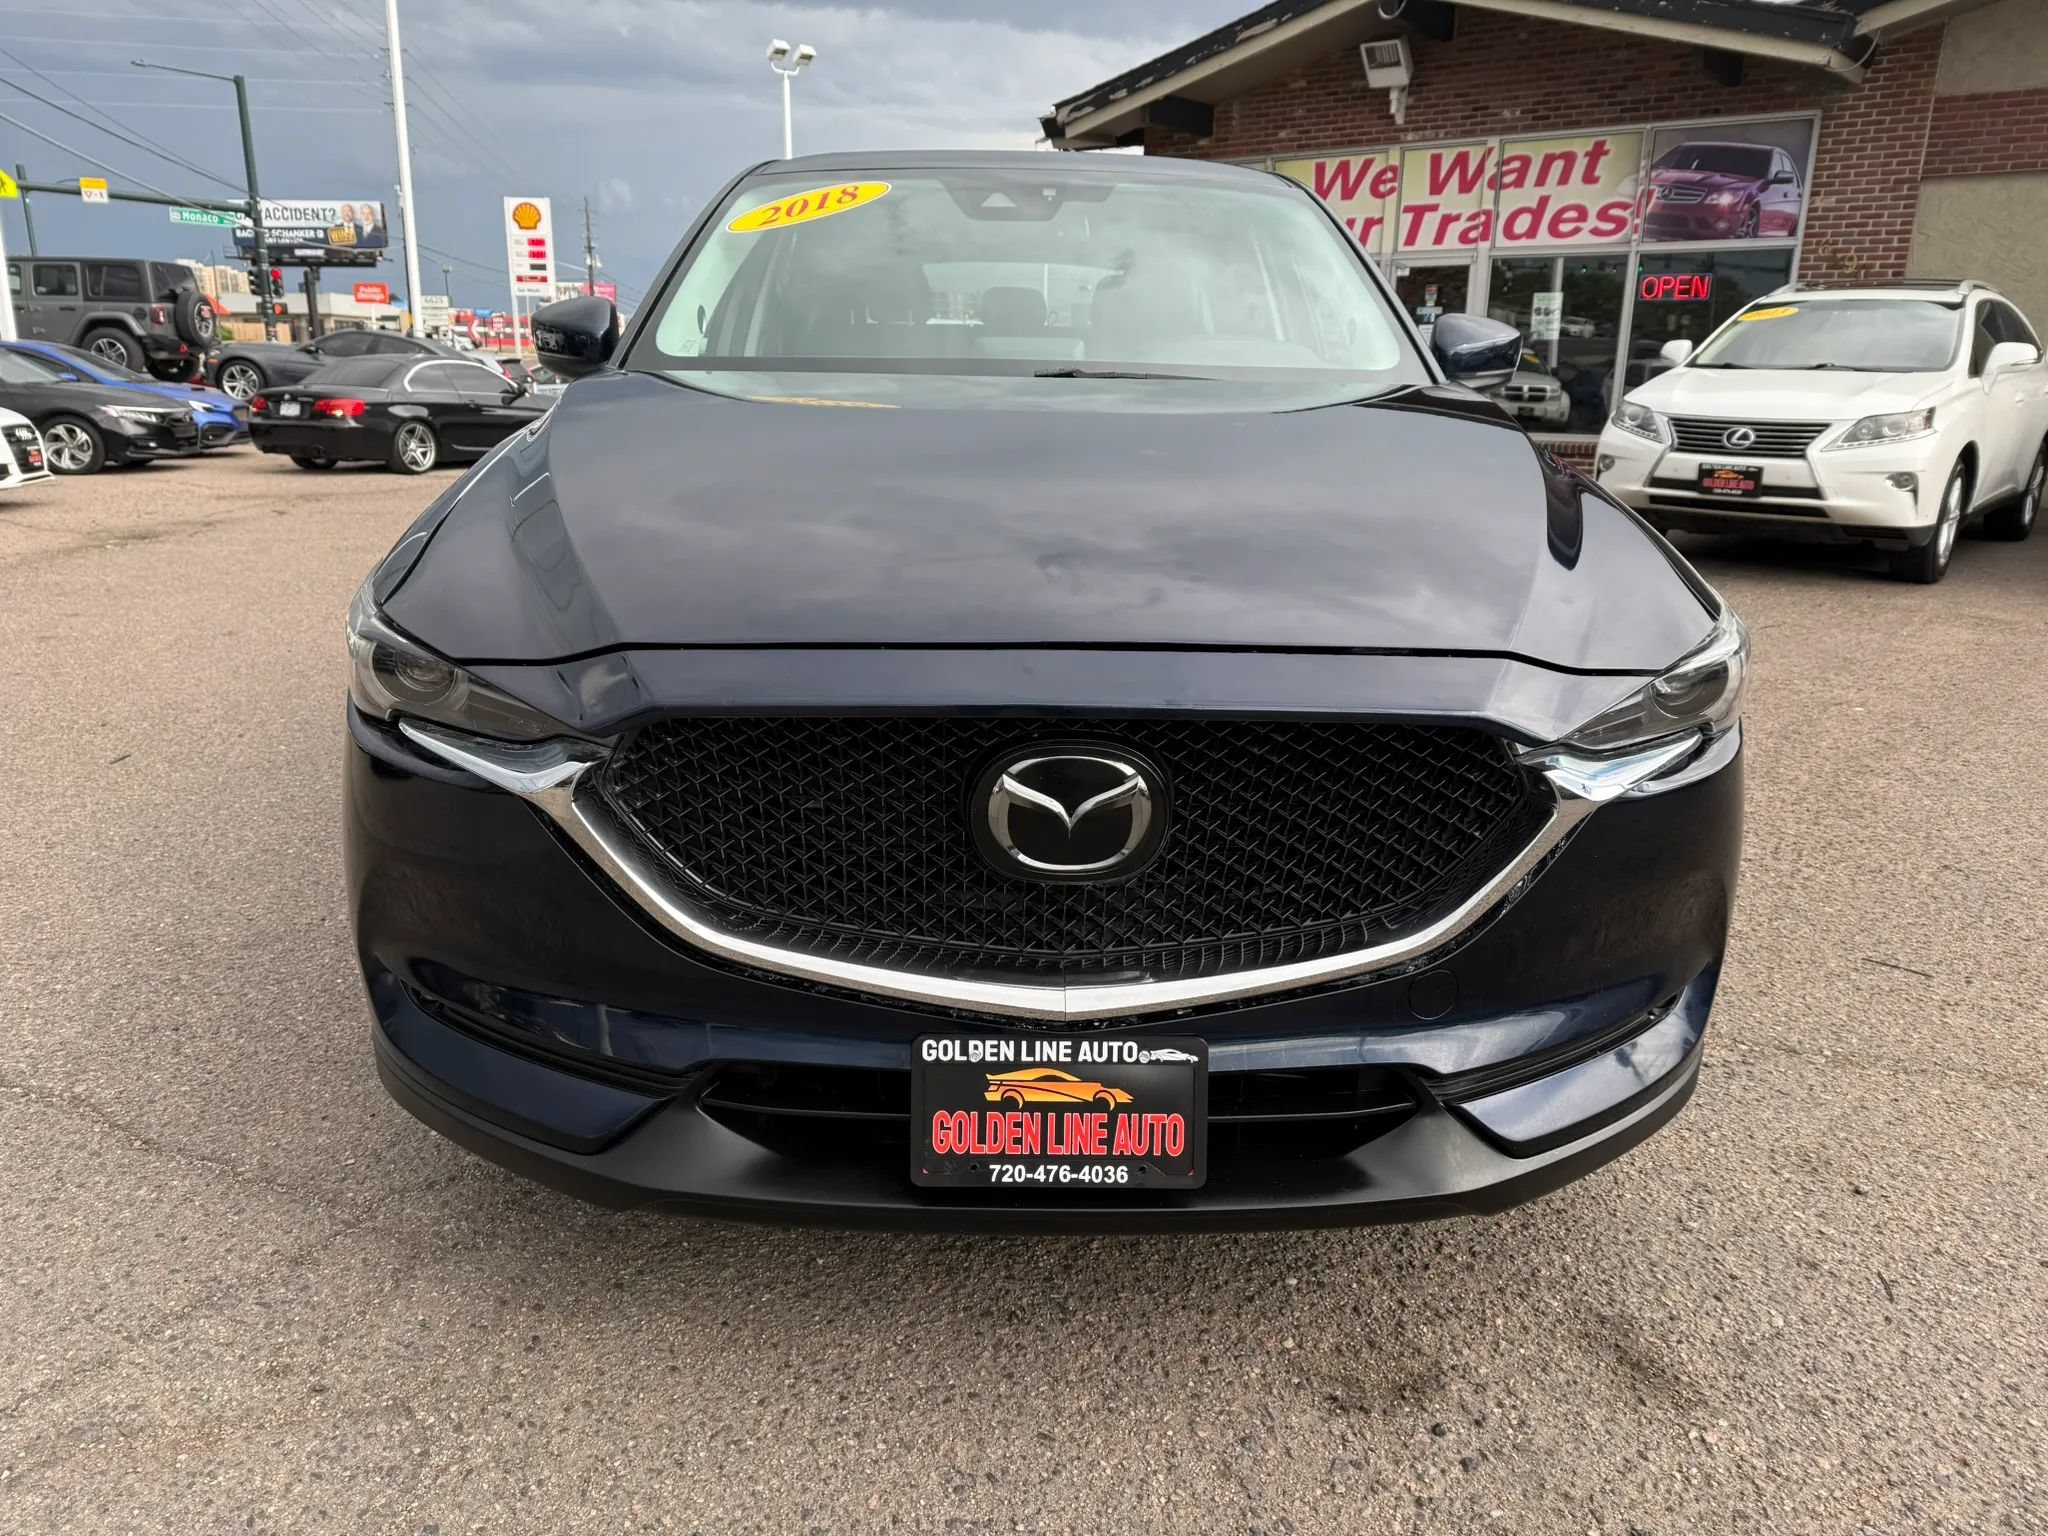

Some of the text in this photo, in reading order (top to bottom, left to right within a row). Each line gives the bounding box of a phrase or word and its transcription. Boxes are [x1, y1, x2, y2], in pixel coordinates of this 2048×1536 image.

[1313, 139, 1611, 201] We Want
[182, 211, 219, 224] Monaco
[264, 207, 336, 222] ACCIDENT?
[758, 184, 860, 227] 2018
[1402, 188, 1657, 246] Trades!
[1641, 275, 1711, 300] OPEN
[921, 1039, 1138, 1063] GOLDEN LINE AUTO
[932, 1110, 1185, 1157] GOLDEN LINE AUTO
[989, 1164, 1128, 1184] 720-476-4036
